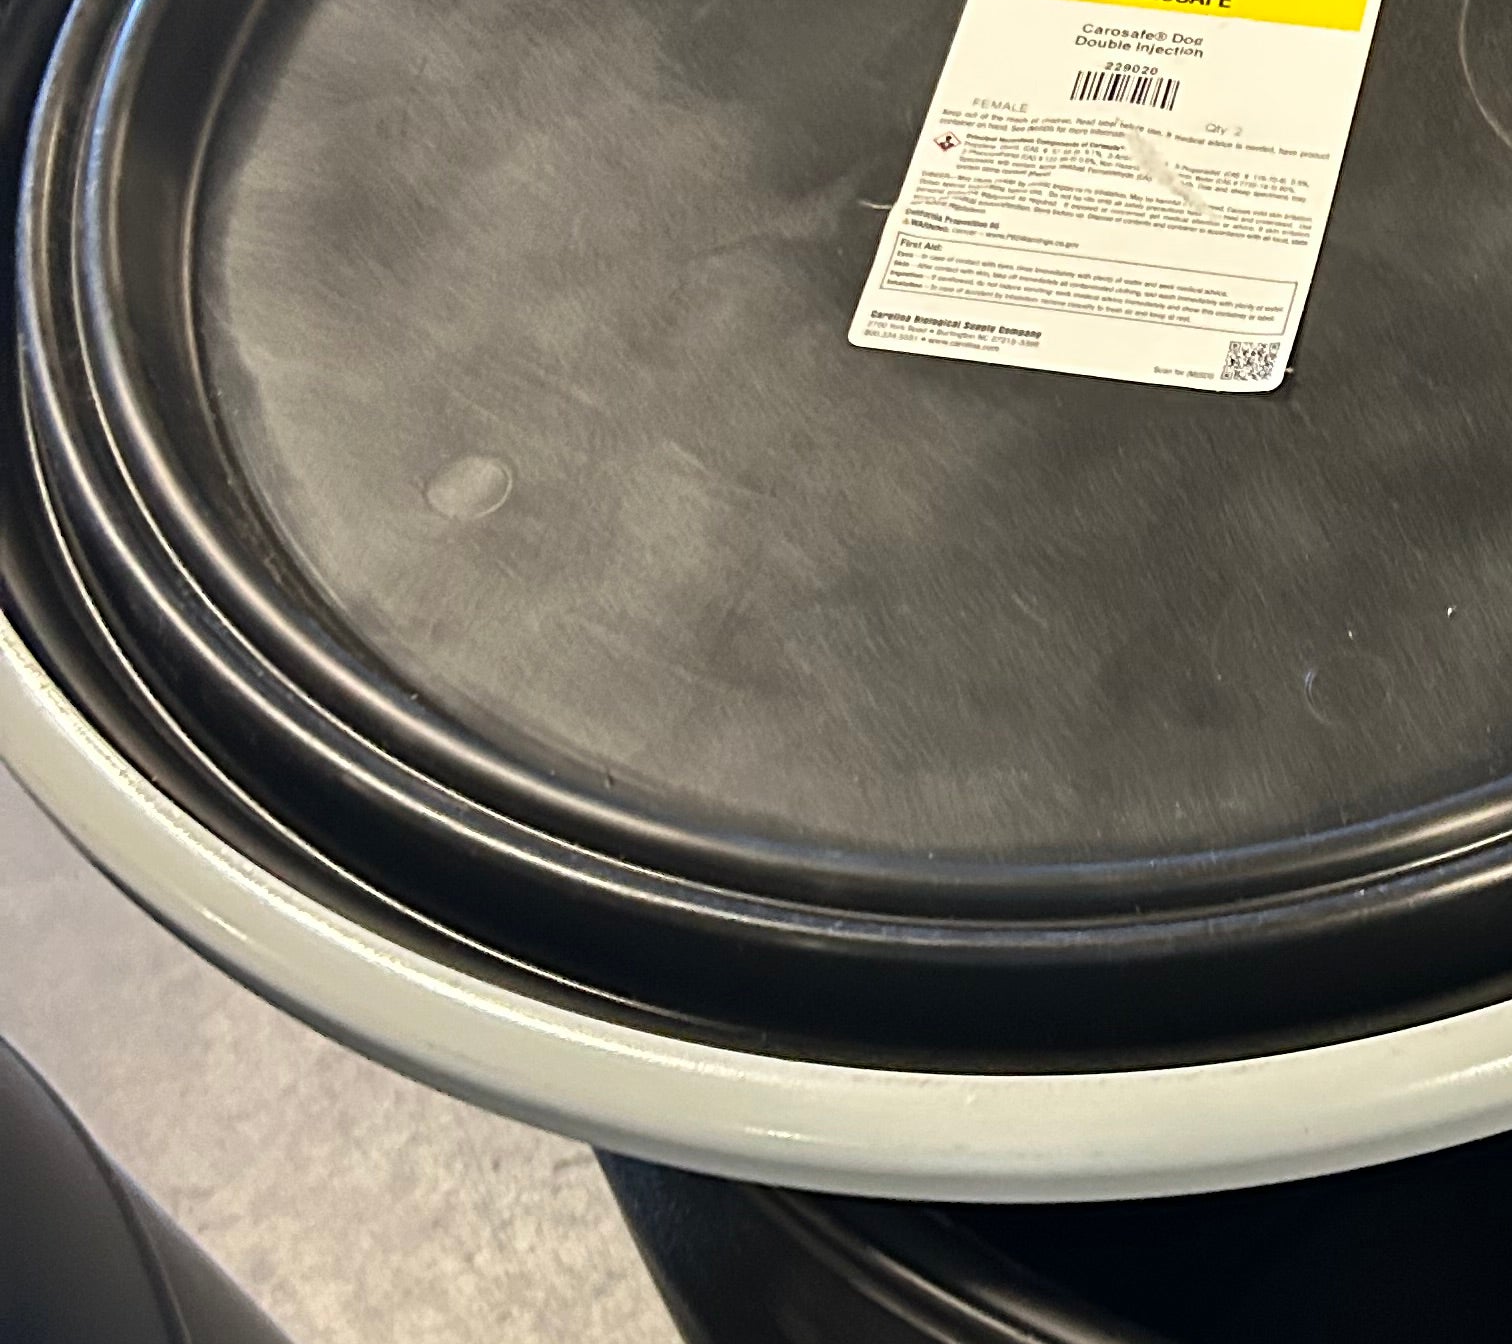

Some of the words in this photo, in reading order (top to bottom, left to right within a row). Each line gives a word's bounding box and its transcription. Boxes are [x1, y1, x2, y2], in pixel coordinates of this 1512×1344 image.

[1075, 35, 1131, 51] Double
[1136, 42, 1204, 59] Injection
[1104, 61, 1159, 75] 229020
[972, 98, 1028, 113] FEMALE
[1205, 123, 1228, 135] Qty
[1234, 126, 1243, 136] 2
[900, 238, 922, 249] First
